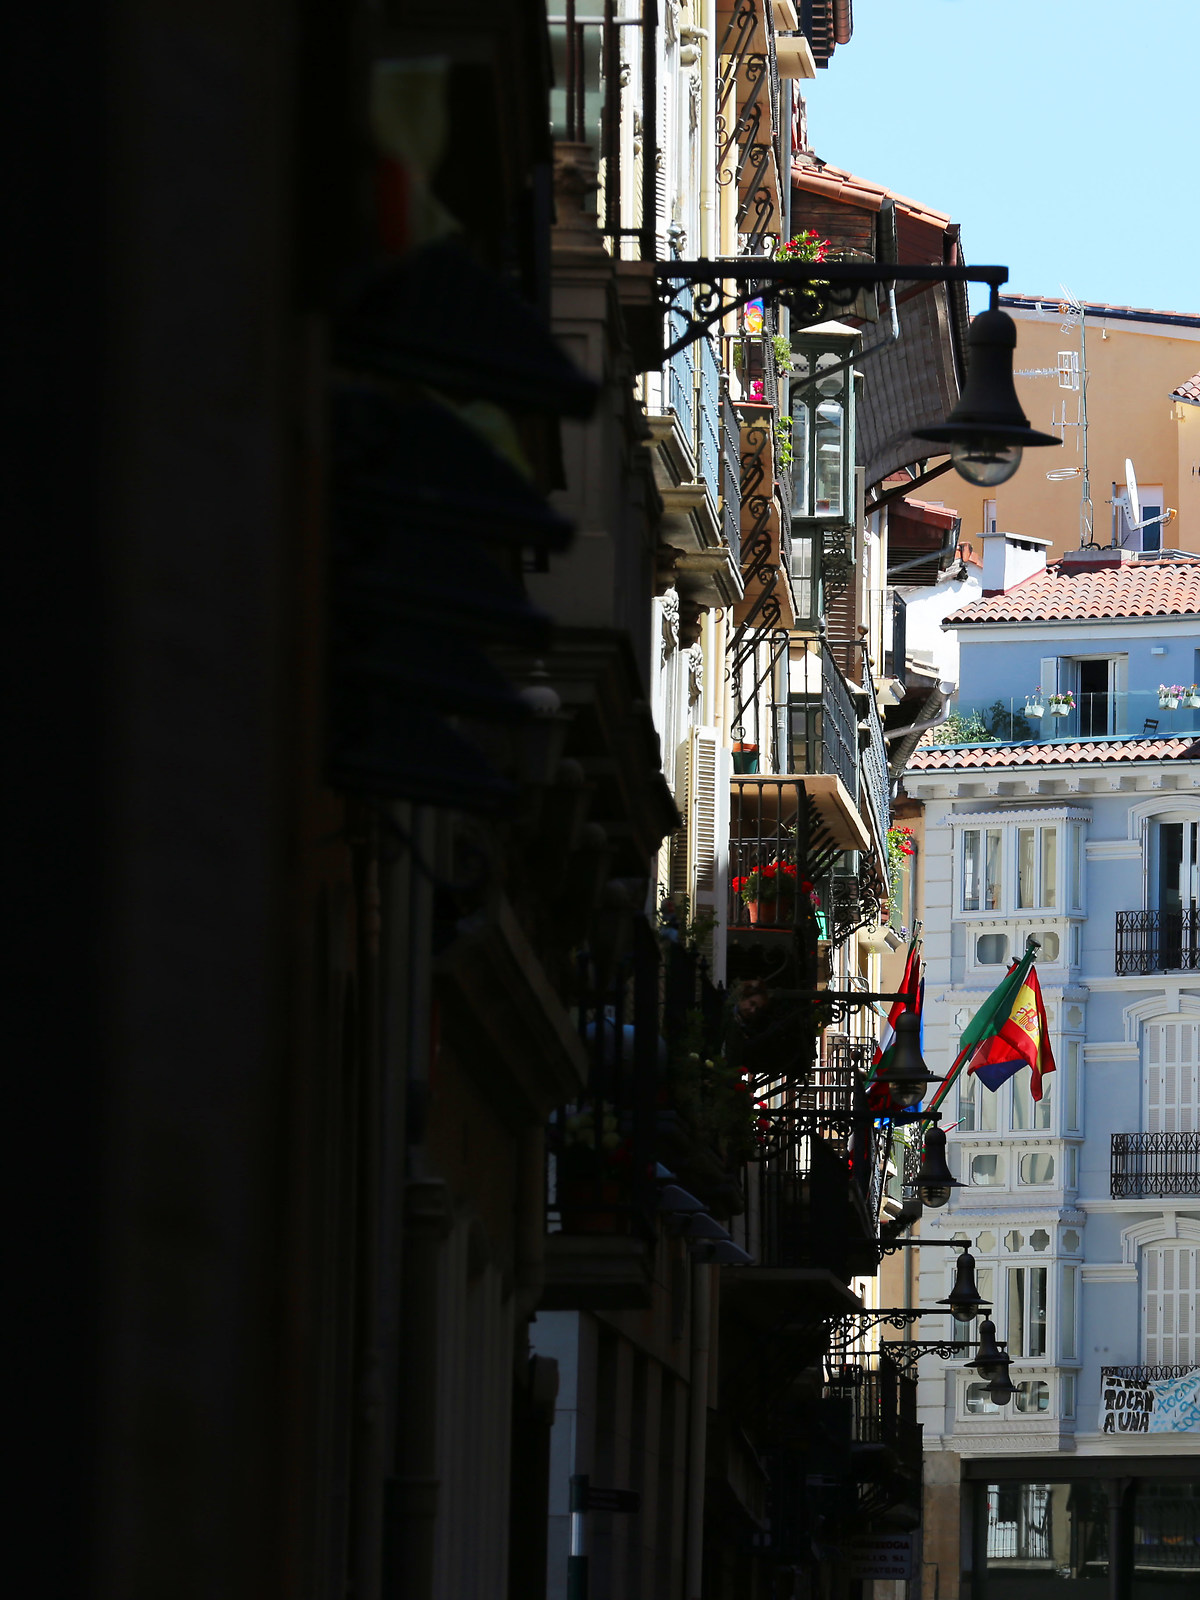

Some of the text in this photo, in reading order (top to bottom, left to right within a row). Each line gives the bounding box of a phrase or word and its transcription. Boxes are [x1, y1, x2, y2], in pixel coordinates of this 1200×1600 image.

[1104, 1389, 1155, 1412] TOCAN
[1103, 1411, 1150, 1433] A UNA
